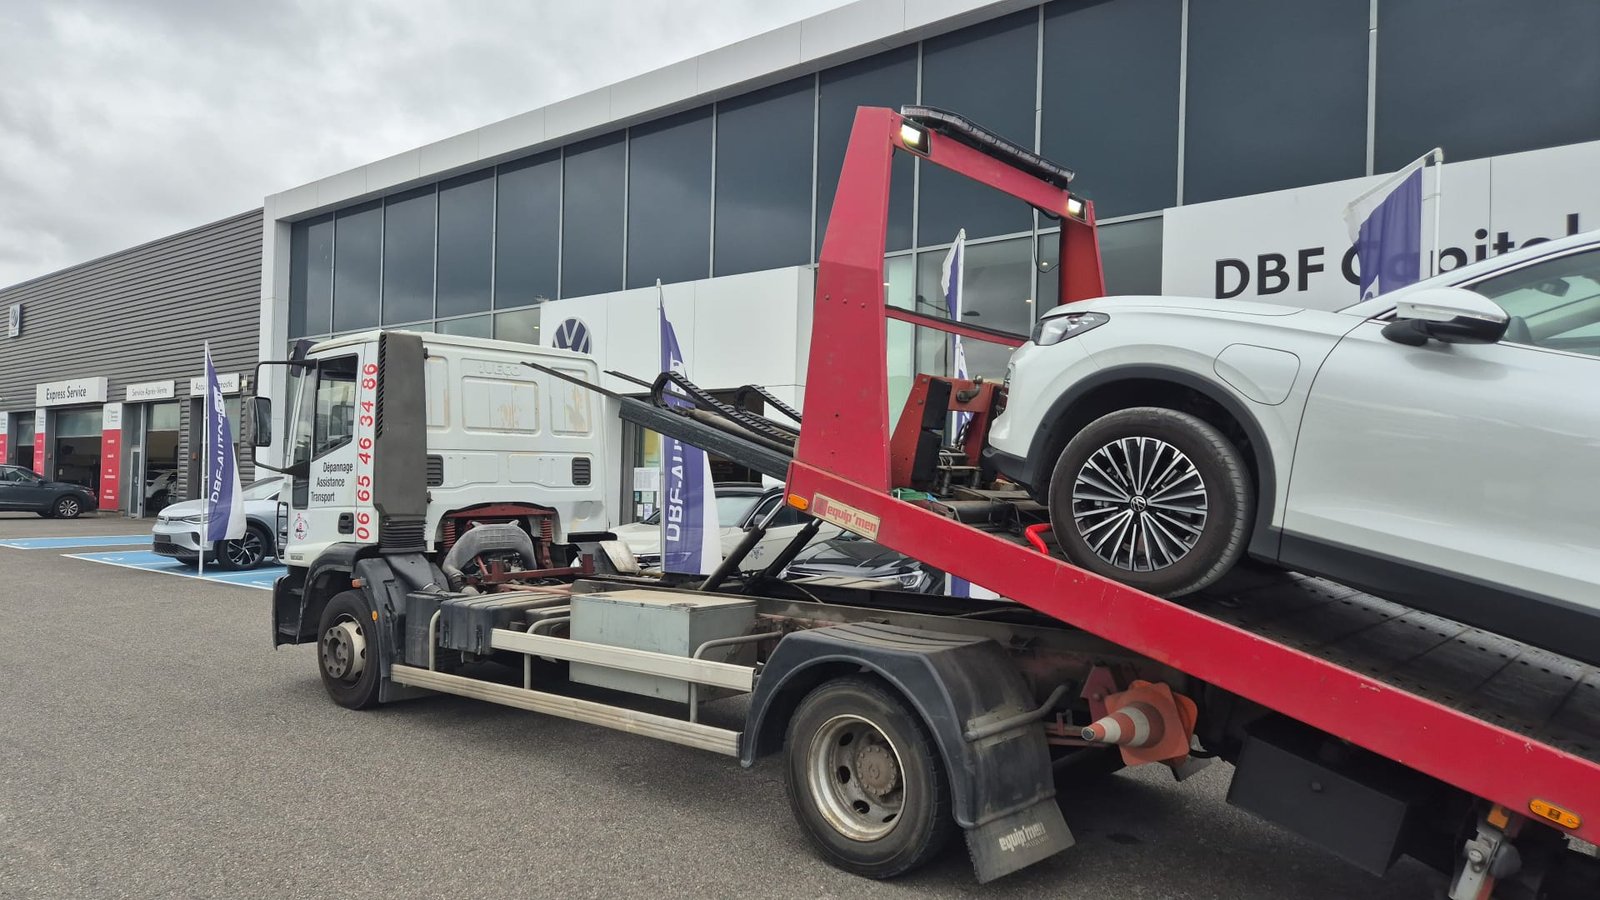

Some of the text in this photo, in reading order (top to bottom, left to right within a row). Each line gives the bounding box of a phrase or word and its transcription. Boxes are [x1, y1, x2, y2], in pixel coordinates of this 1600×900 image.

[1215, 246, 1325, 300] DBF
[46, 385, 87, 403] Express Service
[356, 363, 379, 540] 06 65 46 34 86
[322, 461, 354, 475] Dépannage
[316, 476, 346, 488] Assistance
[311, 491, 336, 504] Transport
